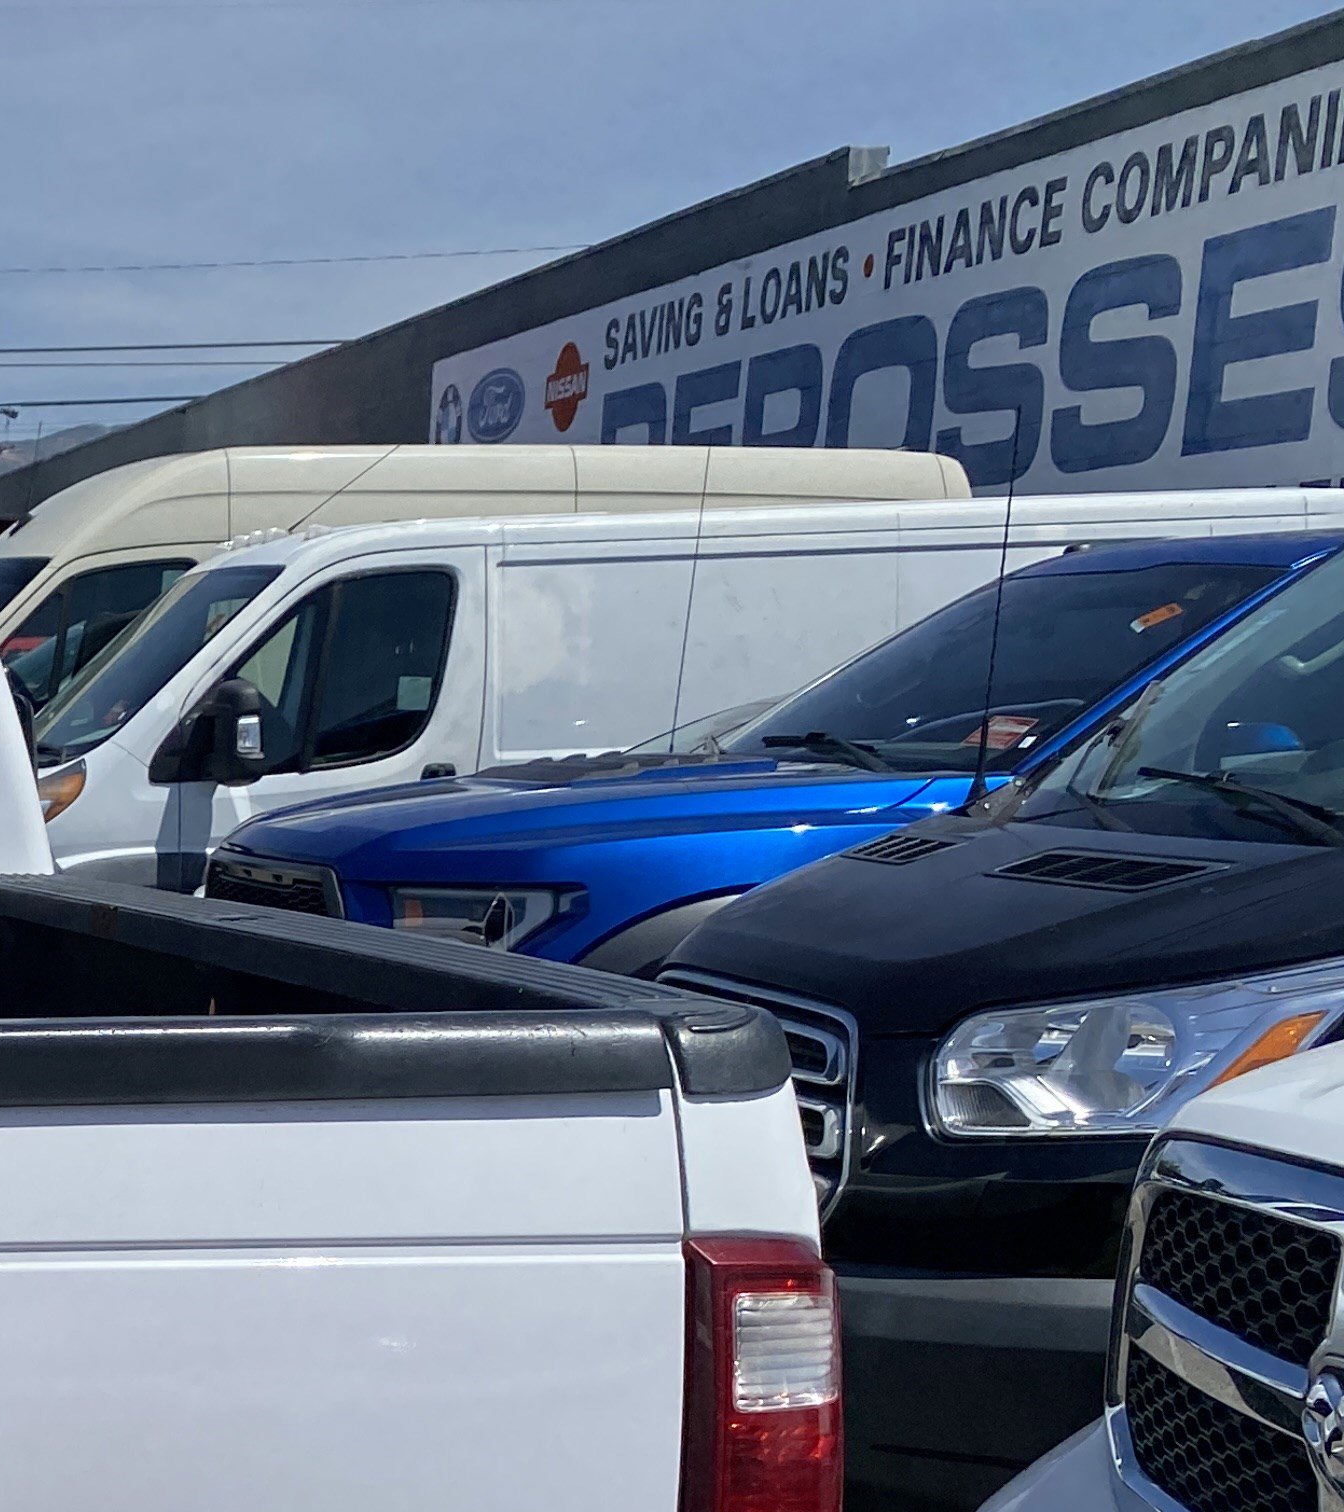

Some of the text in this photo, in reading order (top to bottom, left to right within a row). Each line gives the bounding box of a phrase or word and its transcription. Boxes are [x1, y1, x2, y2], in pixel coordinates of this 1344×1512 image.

[600, 204, 1344, 490] POSSE
[603, 87, 1344, 371] SAVING & LOANS FINANCE COMPANI
